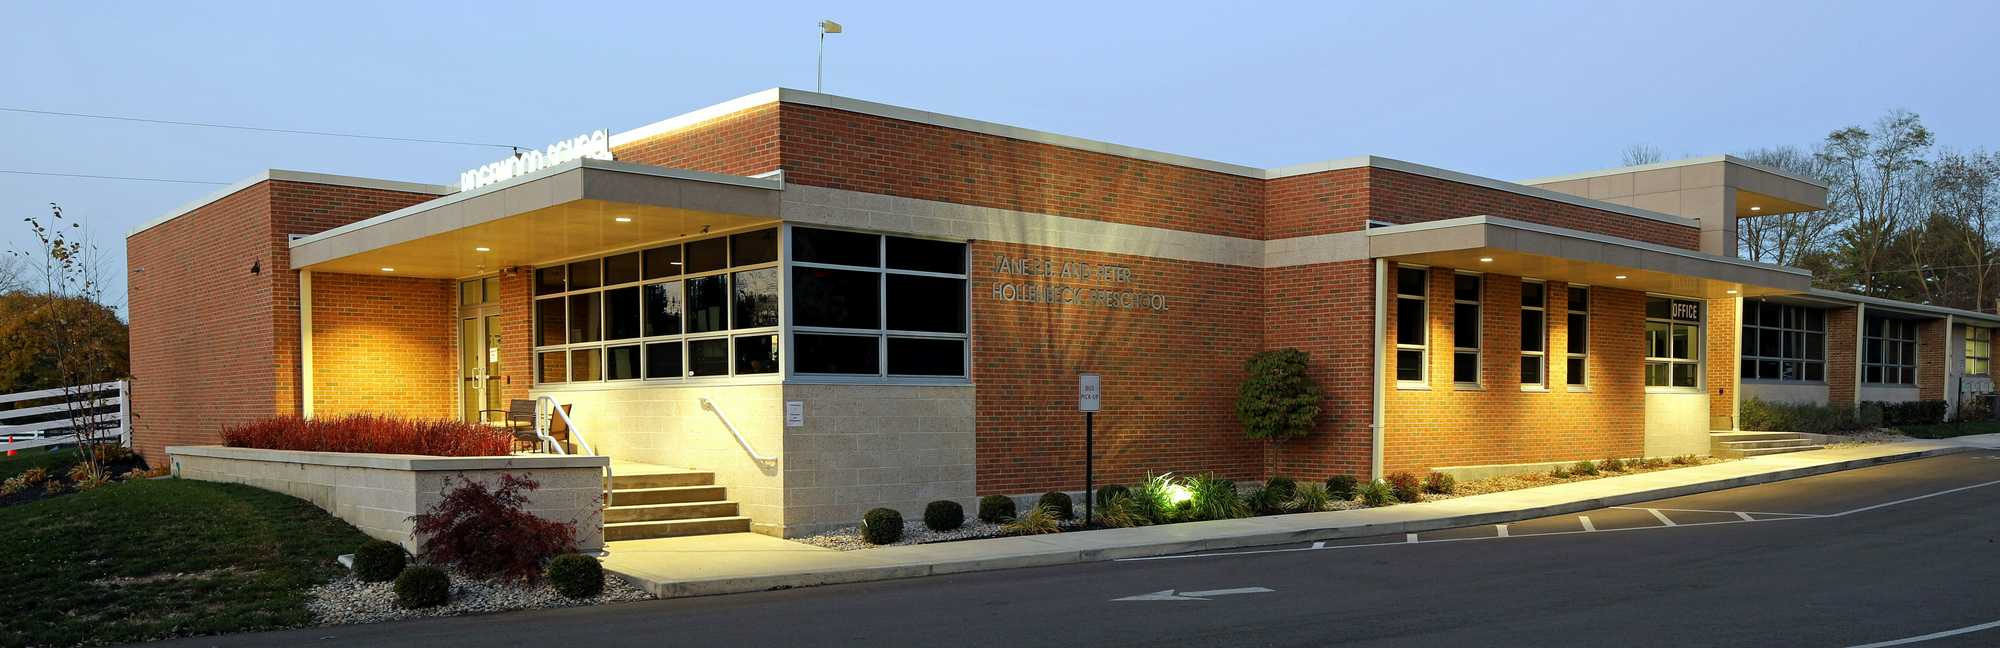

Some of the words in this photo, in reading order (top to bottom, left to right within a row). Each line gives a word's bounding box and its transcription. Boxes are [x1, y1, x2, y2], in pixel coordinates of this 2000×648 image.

[992, 255, 1031, 276] JANE
[1060, 261, 1090, 282] AND
[1097, 264, 1133, 283] PETER
[992, 281, 1081, 305] HOLLENBECK
[1089, 287, 1169, 311] PRESCHOOL
[1672, 303, 1697, 319] OFFICE
